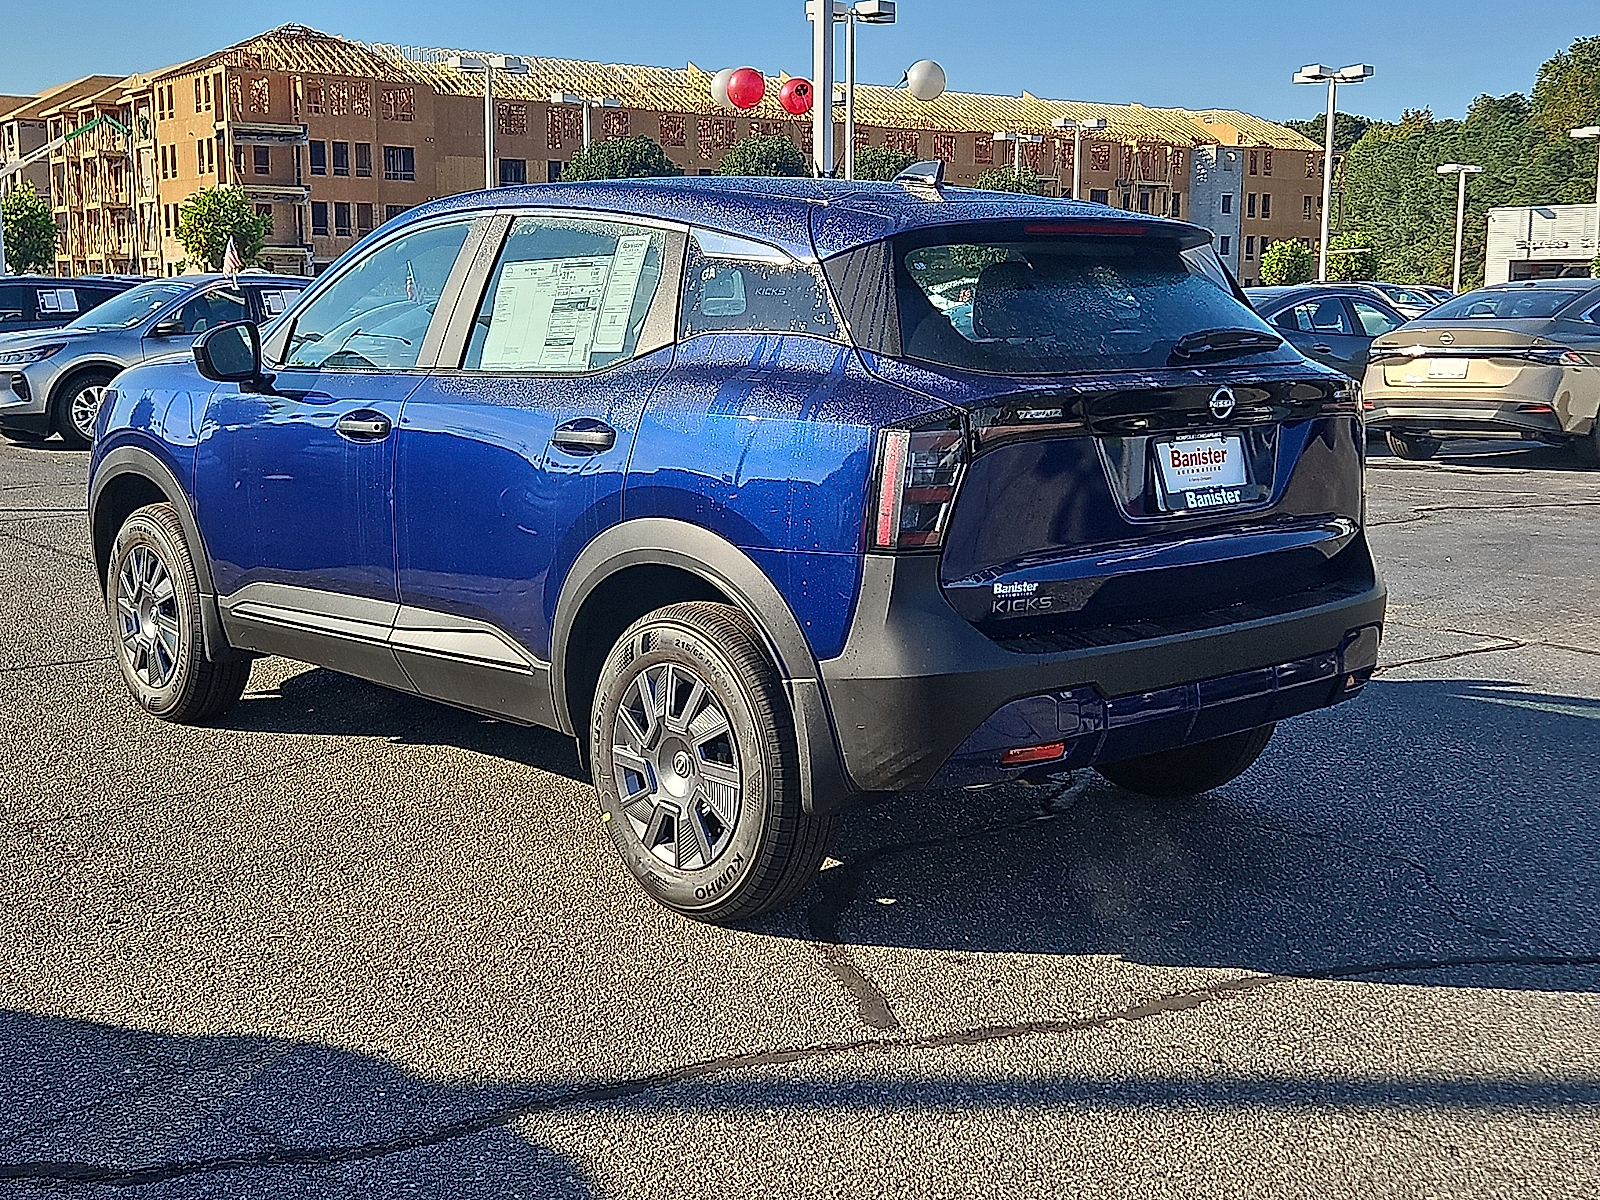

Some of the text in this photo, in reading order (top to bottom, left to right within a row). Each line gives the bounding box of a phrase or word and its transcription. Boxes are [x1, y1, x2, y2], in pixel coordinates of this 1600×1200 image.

[1515, 240, 1569, 251] Express
[754, 287, 786, 296] KICKS
[1170, 446, 1228, 469] Banister
[1185, 489, 1241, 508] Banister
[993, 581, 1039, 595] Banister
[991, 596, 1053, 613] KICKS
[694, 850, 745, 900] KUMHO
